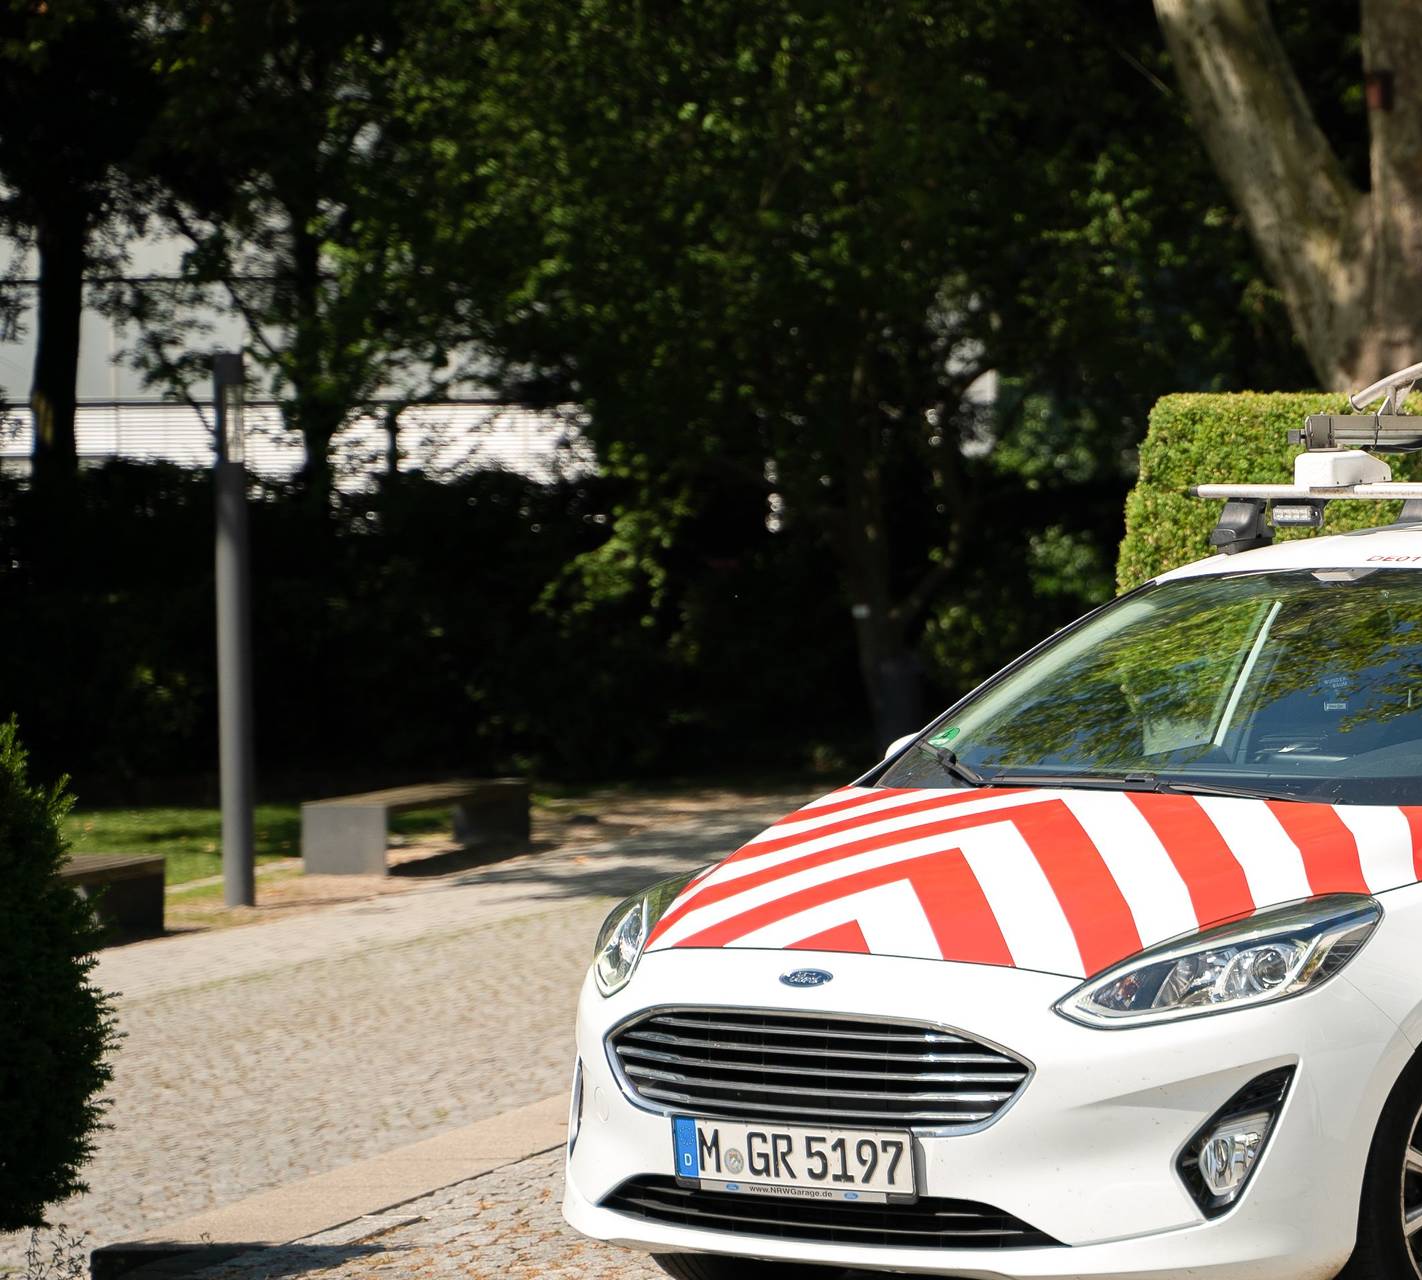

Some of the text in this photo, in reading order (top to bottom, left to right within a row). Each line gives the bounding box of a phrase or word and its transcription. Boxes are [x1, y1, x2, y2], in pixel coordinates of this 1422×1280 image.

[684, 1153, 692, 1167] D
[697, 1128, 904, 1185] M GR 5197
[749, 1185, 833, 1198] www.NRWGarage.de
